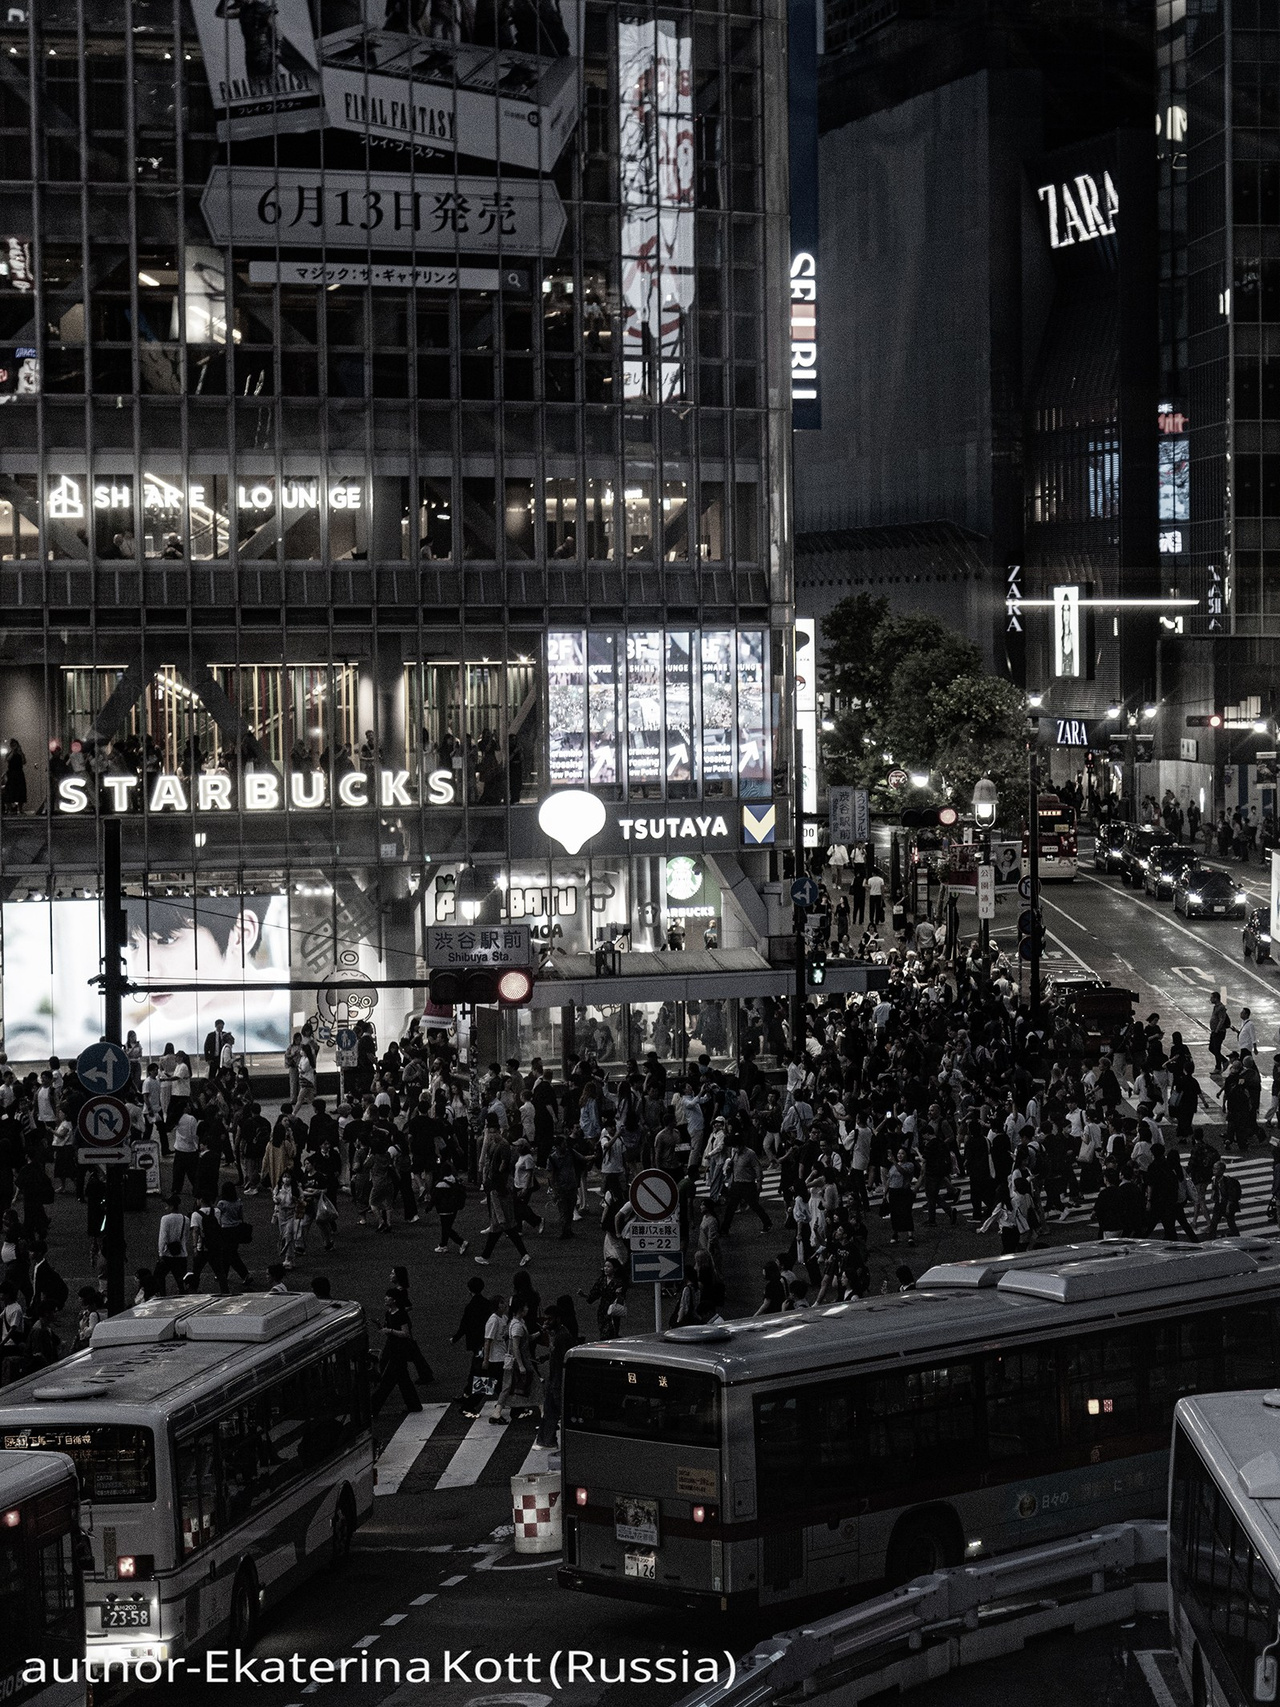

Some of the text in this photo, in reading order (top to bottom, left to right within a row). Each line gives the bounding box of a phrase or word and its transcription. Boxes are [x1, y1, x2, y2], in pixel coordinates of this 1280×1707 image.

[345, 92, 456, 139] FINAL FANTASY
[257, 185, 517, 236] 6月13日発売
[1037, 170, 1119, 249] ZARA
[94, 485, 361, 509] SHARE LOUNGE
[1006, 565, 1023, 632] ZARA
[1057, 720, 1088, 746] ZARA
[58, 770, 454, 813] STARBUCKS
[618, 815, 729, 841] TSUTAYA
[434, 931, 522, 950] 渋谷駅前
[448, 951, 512, 963] Shibuya Sta.
[631, 1225, 678, 1236] 路線バスを除く
[639, 1238, 672, 1249] 6-22
[110, 1610, 148, 1626] 23-58
